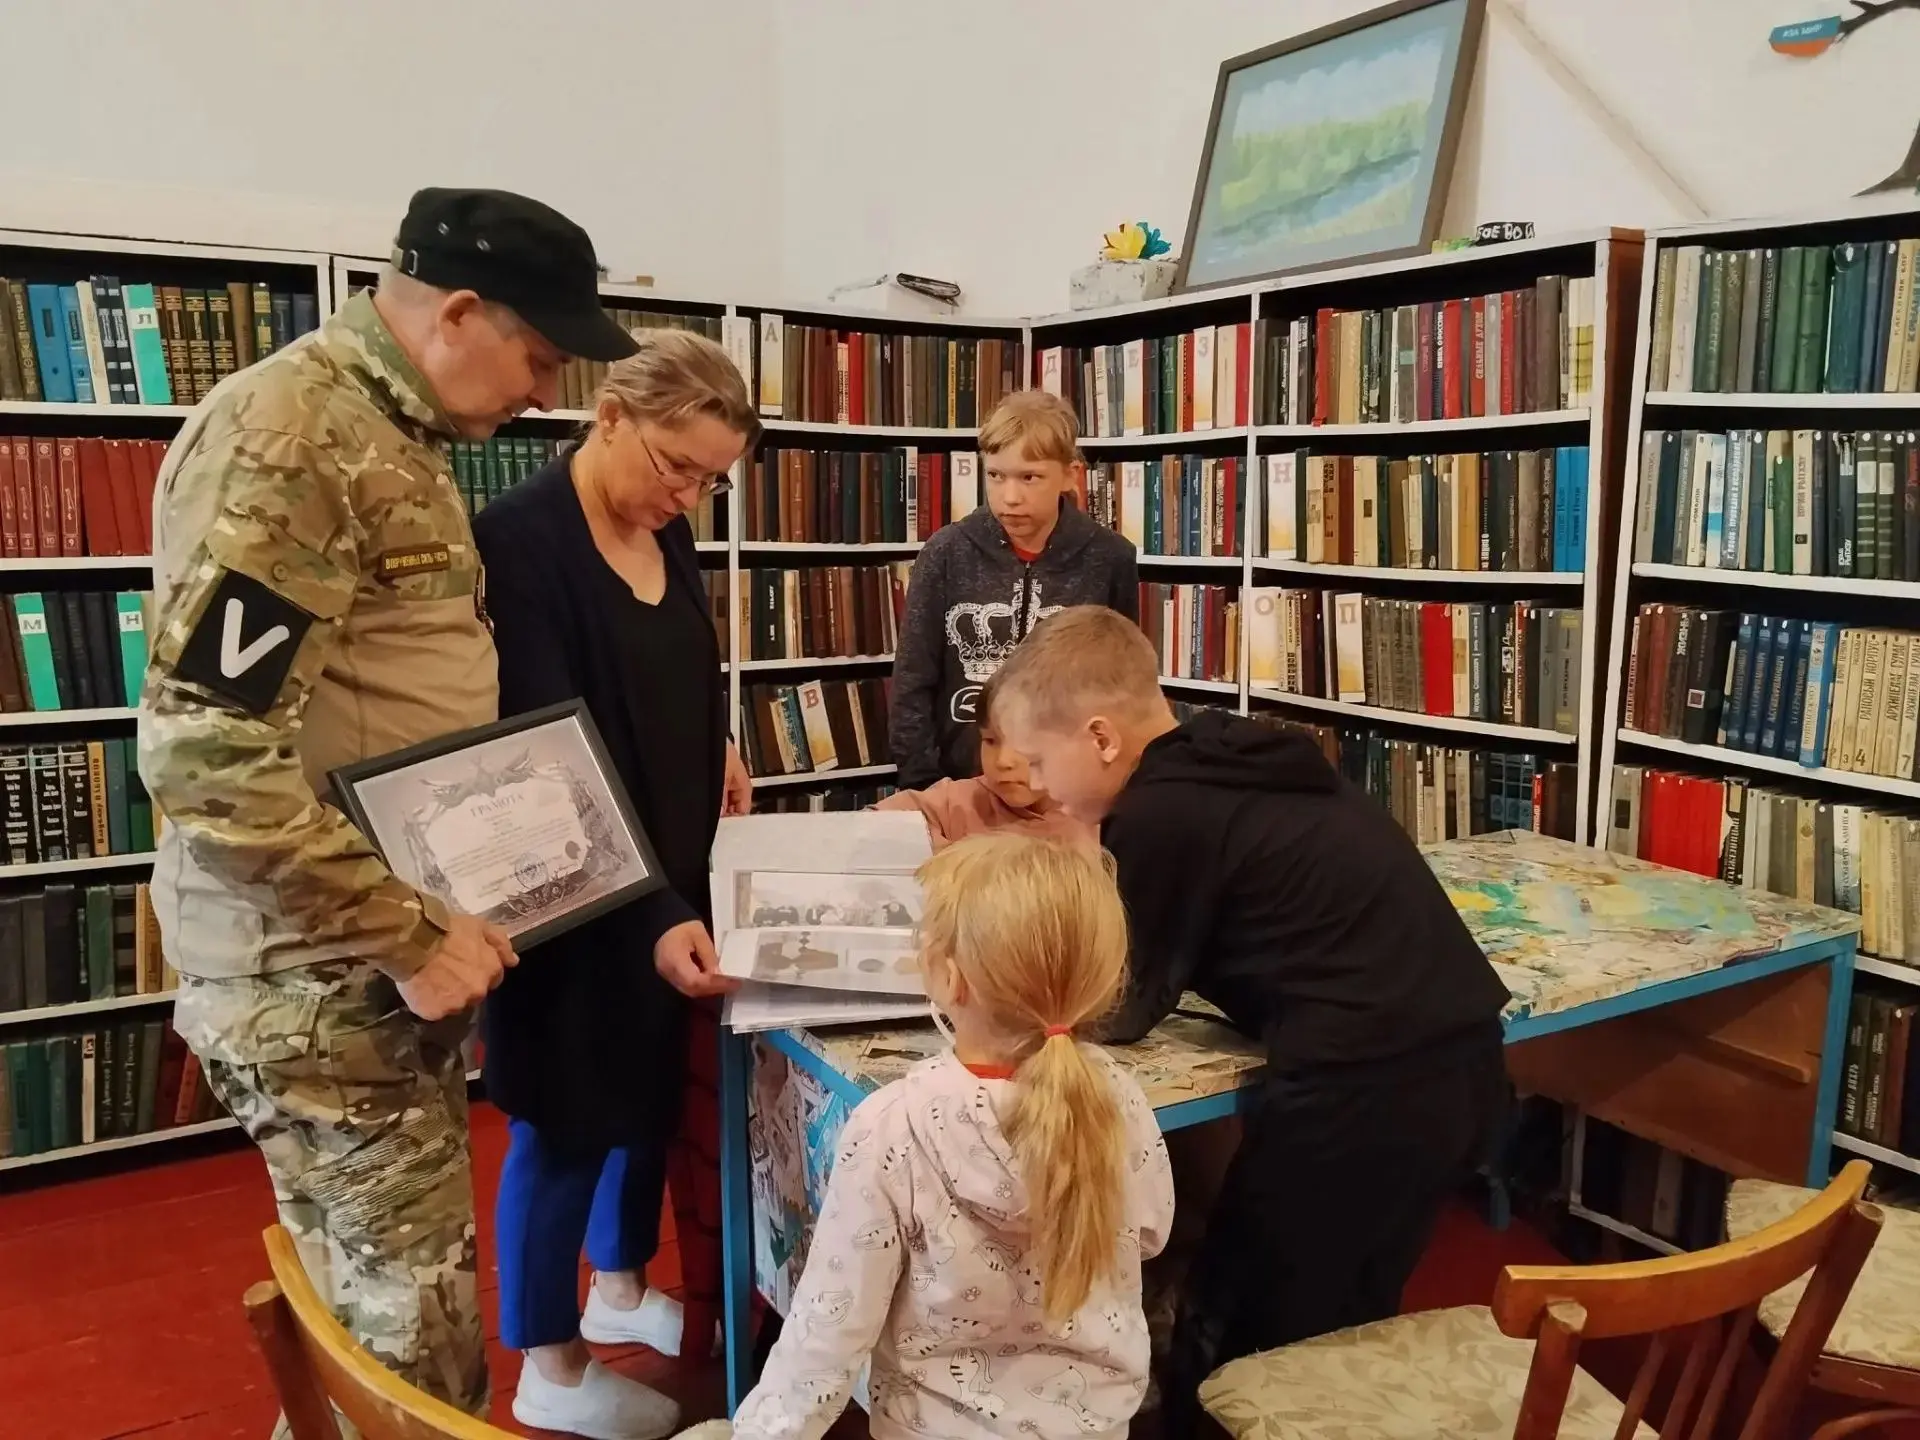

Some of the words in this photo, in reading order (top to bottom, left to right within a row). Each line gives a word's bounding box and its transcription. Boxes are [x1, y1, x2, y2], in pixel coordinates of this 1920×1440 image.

[764, 314, 779, 344] А
[1044, 354, 1058, 377] Д
[957, 458, 971, 476] Б
[1272, 463, 1292, 484] Н
[1254, 596, 1275, 615] О
[1340, 603, 1357, 625] П
[23, 619, 42, 631] М
[126, 614, 140, 625] Н
[221, 598, 290, 679] V
[804, 689, 819, 708] В
[1856, 748, 1866, 767] 4
[1901, 754, 1912, 772] 7
